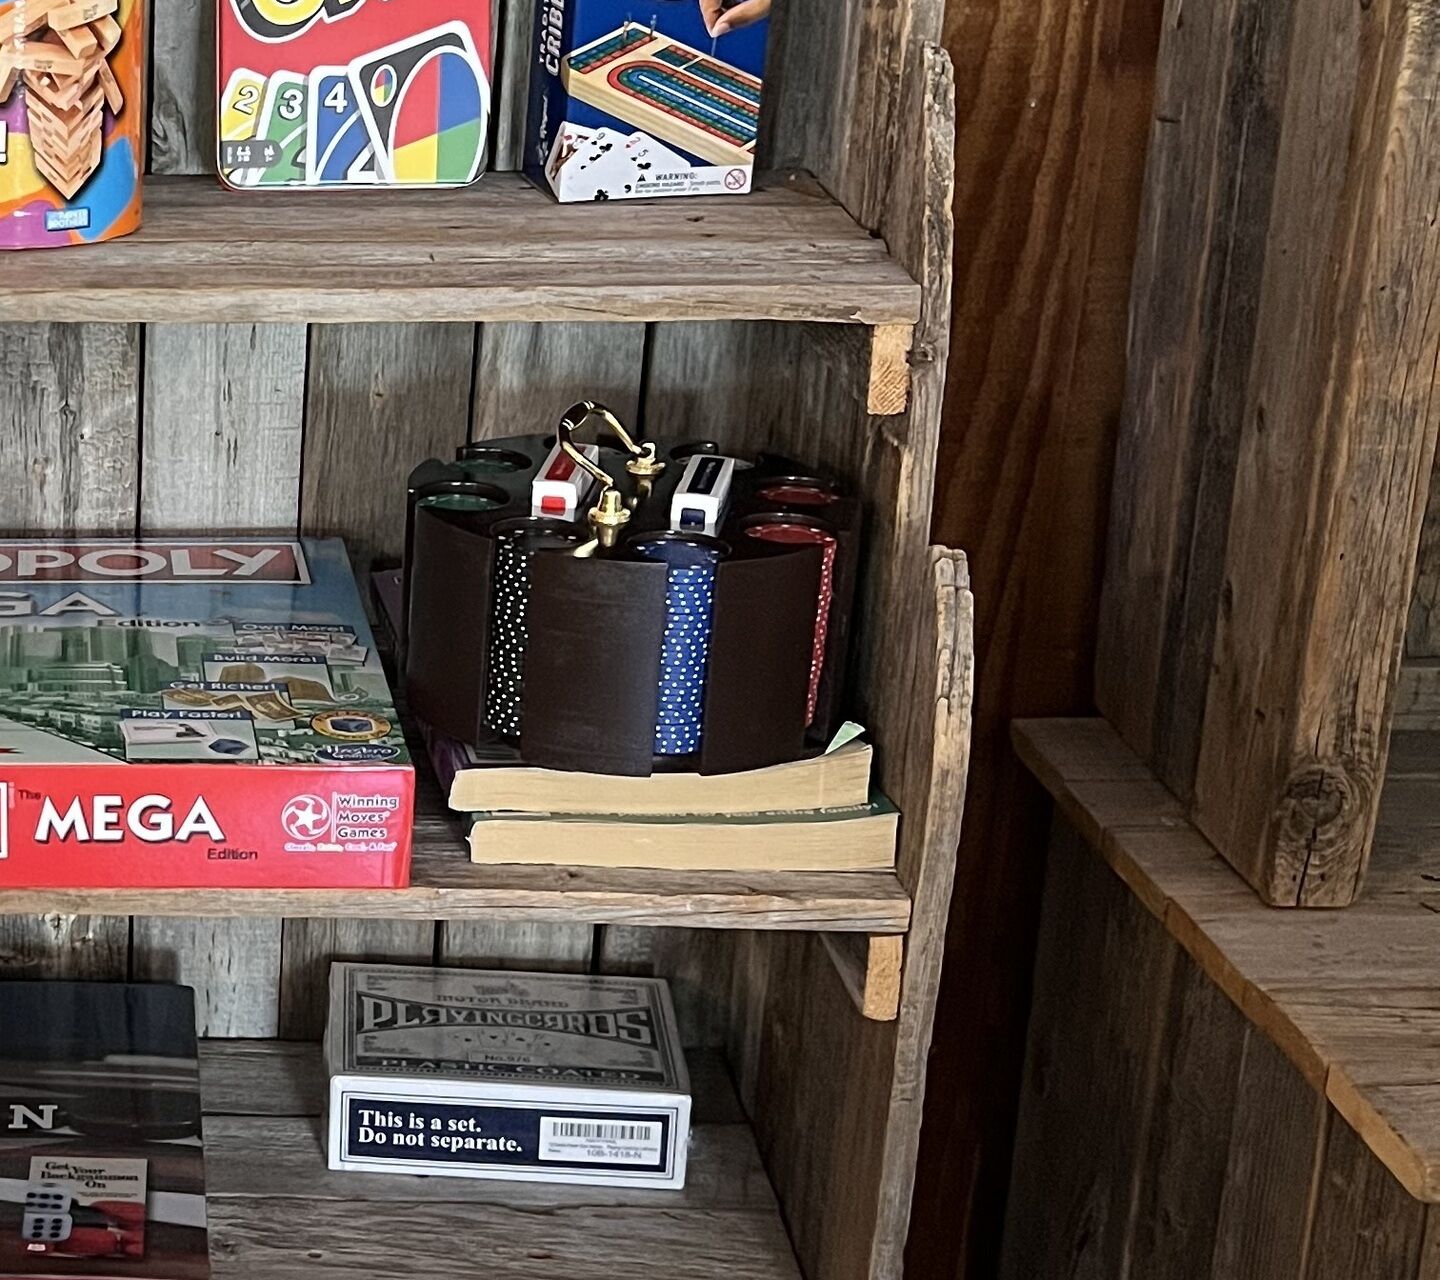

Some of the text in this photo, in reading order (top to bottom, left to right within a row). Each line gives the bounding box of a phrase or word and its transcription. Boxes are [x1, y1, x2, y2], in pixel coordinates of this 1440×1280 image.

[232, 85, 260, 115] 2
[277, 88, 305, 120] 3
[324, 82, 348, 114] 4
[291, 623, 344, 632] More!
[213, 654, 317, 663] Build More!
[170, 682, 276, 690] Get Richer!
[131, 710, 241, 719] Play Faster!
[338, 796, 398, 809] Winning
[18, 789, 41, 800] The
[34, 793, 227, 843] MEGA
[338, 828, 386, 838] Games
[207, 848, 258, 860] Edition
[437, 994, 502, 1005] MOTOR
[359, 1110, 482, 1132] This is a set.
[359, 1127, 523, 1153] Do not separate.
[45, 1161, 106, 1174] Get Your
[40, 1171, 139, 1181] Backgammon
[84, 1181, 106, 1189] On
